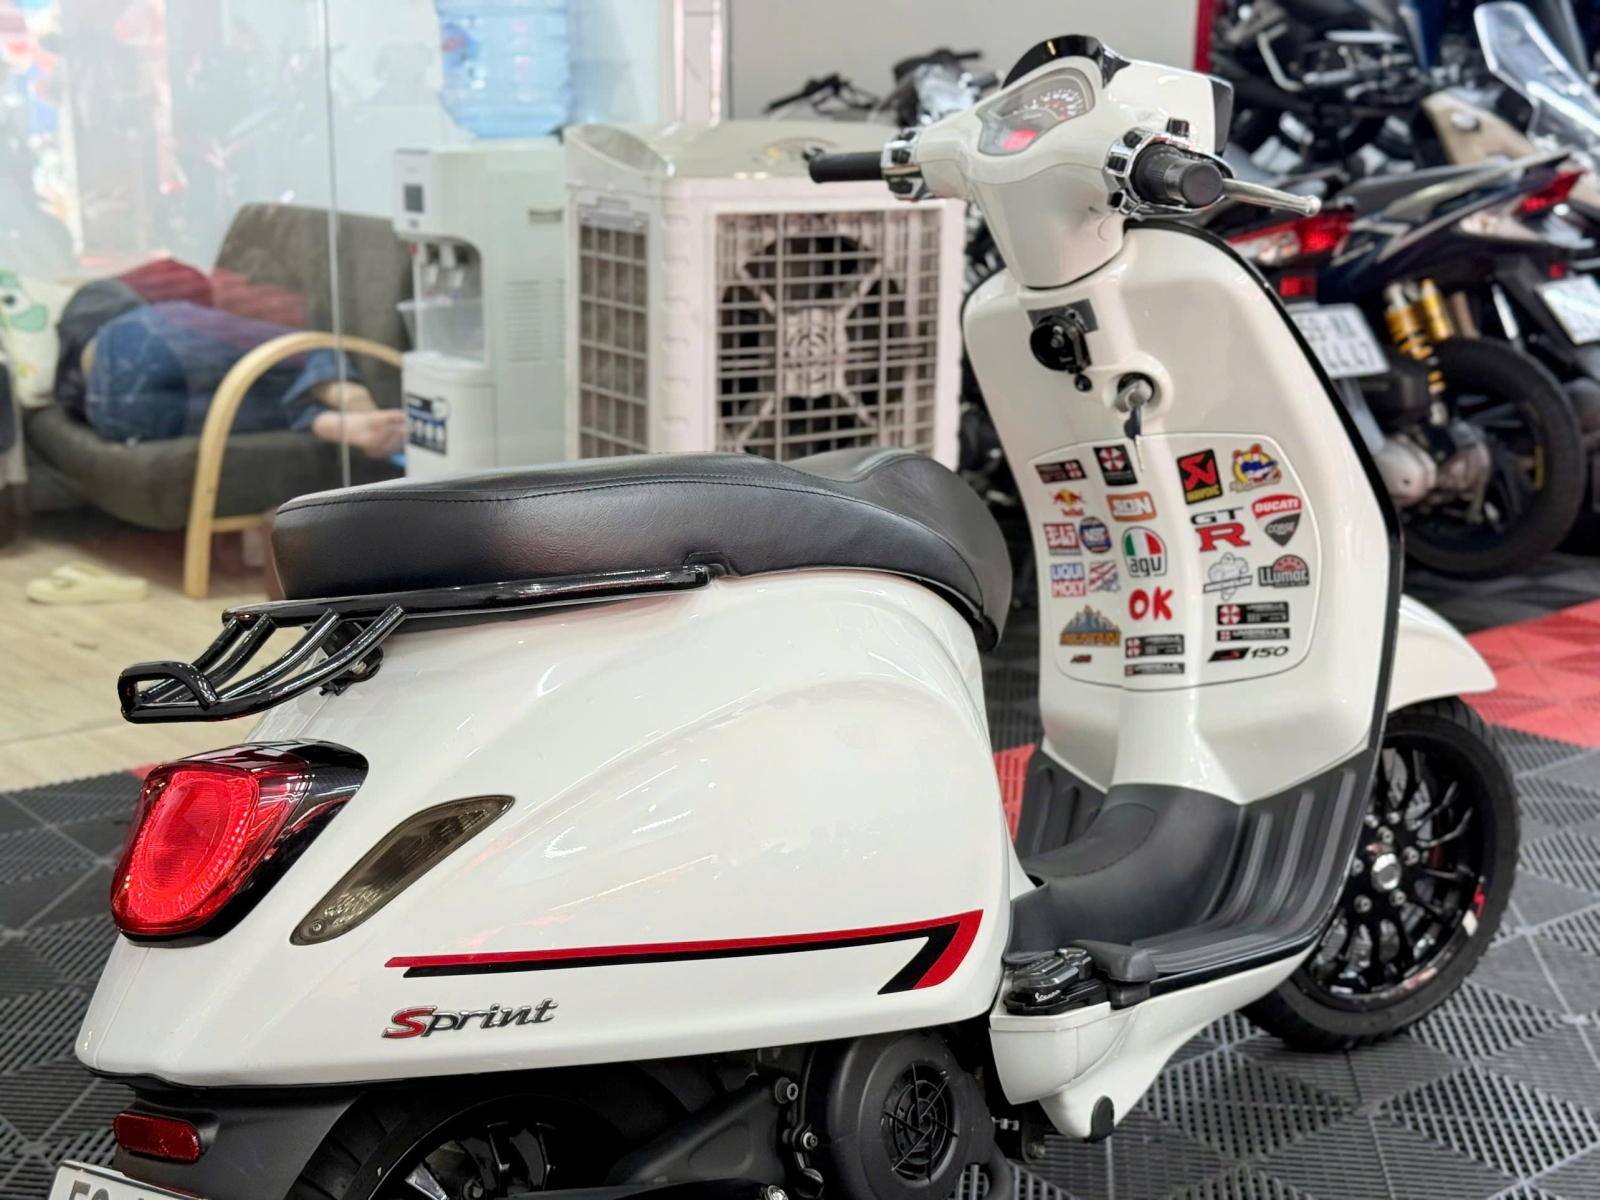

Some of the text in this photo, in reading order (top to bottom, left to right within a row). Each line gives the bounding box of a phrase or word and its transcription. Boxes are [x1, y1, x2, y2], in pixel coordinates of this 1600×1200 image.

[1254, 498, 1299, 513] DUCATI
[1191, 506, 1243, 525] GT
[1195, 522, 1251, 552] R
[1130, 556, 1162, 577] agv
[1259, 567, 1308, 585] LLumar
[1052, 580, 1085, 596] MOLY
[1128, 586, 1173, 622] OK
[1251, 646, 1288, 658] 150
[381, 998, 558, 1038] Sprint
